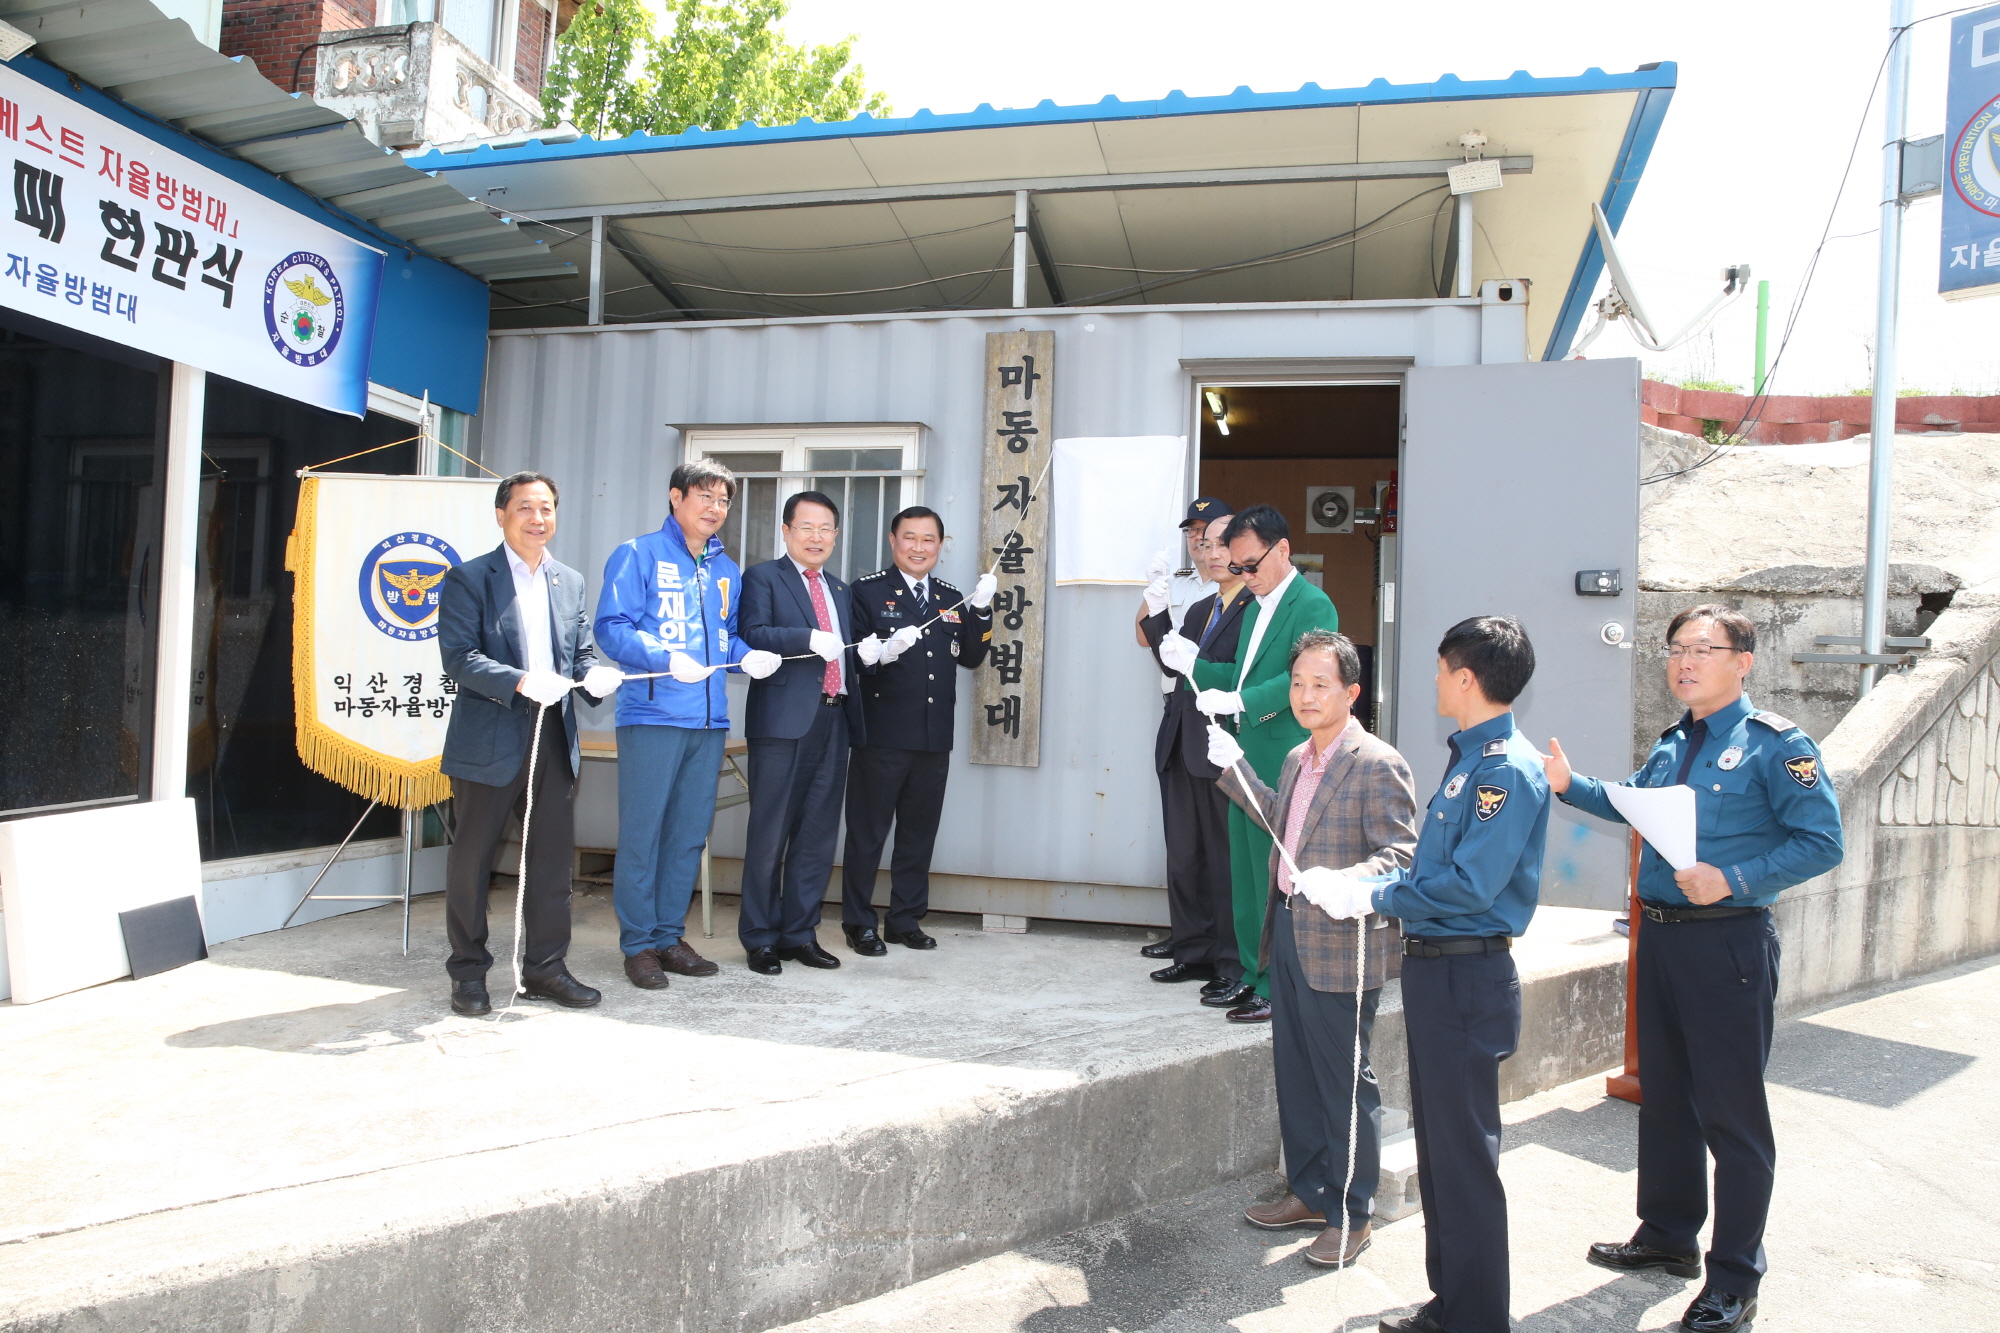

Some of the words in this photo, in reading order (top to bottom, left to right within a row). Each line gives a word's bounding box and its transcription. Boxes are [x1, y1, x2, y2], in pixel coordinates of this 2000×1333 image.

[1958, 111, 1994, 174] PREVENTION
[1960, 173, 1985, 201] CRIME
[98, 198, 243, 309] 현판식
[4, 252, 138, 324] 자율방범대
[265, 261, 289, 295] KOREA
[292, 253, 330, 276] CITIZEN'S
[329, 277, 343, 323] PATROL
[272, 332, 328, 365] 자율방범대
[381, 533, 448, 552] 익산경찰서
[656, 560, 687, 650] 문재인
[716, 576, 731, 621] 1
[333, 695, 454, 718] 마동자율방
